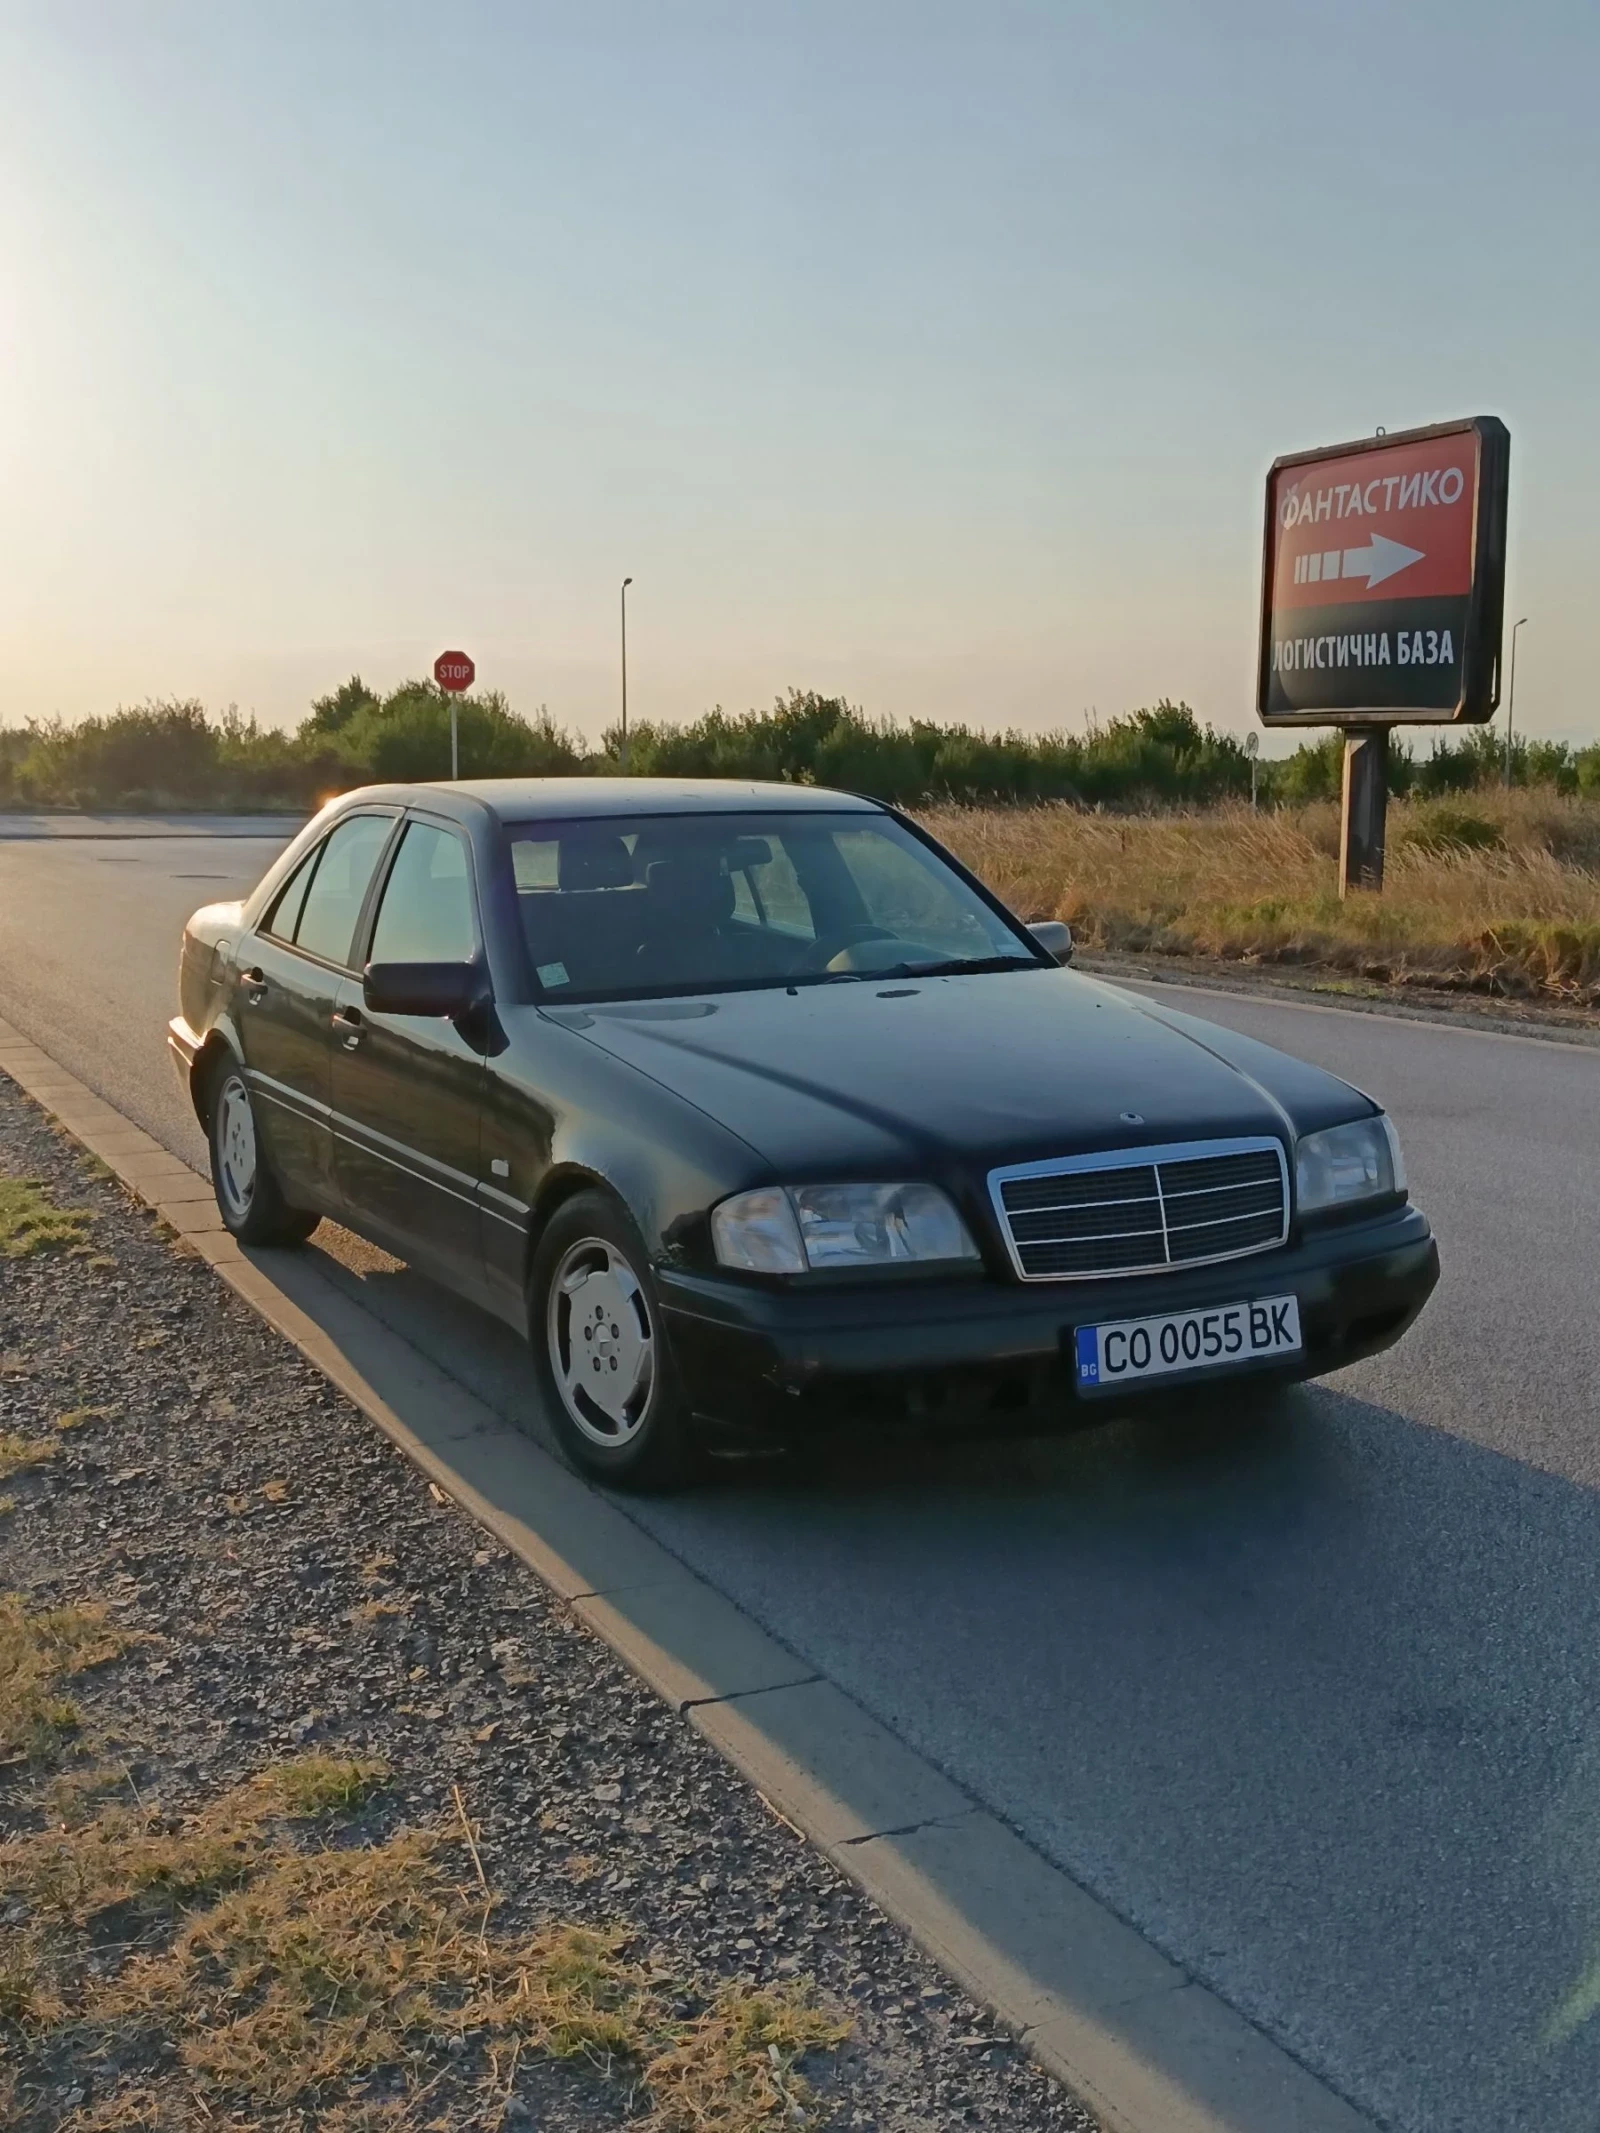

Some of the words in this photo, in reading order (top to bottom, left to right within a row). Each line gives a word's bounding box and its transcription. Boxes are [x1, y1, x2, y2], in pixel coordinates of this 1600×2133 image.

[1279, 467, 1464, 530] ФАНТАСТИКО
[440, 664, 470, 679] STOP
[1272, 632, 1391, 672] ЛОГИСТИЧНА
[1397, 630, 1454, 665] БАЗА
[1159, 1311, 1243, 1364] 0055
[1250, 1302, 1294, 1349] BK
[1081, 1363, 1097, 1378] BG
